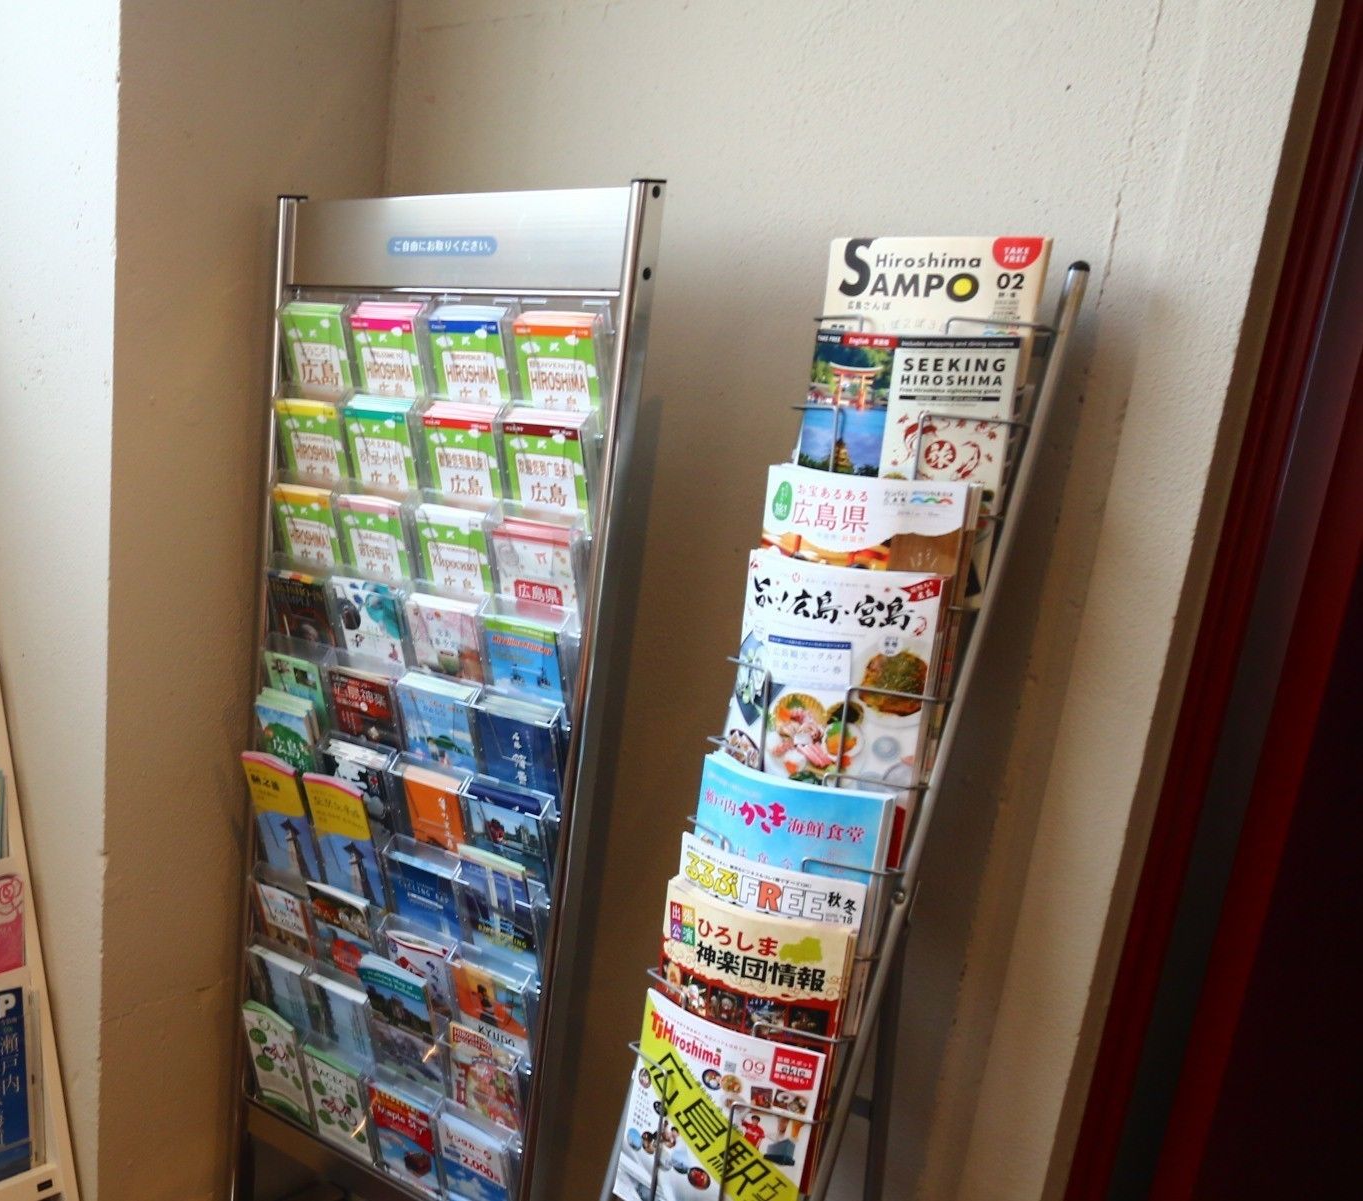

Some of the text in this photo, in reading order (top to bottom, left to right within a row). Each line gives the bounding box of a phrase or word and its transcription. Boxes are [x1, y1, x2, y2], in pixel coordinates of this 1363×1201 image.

[393, 239, 492, 253] ご自由にお取りください。
[1003, 246, 1030, 256] TAKE
[875, 252, 981, 268] Hiroshima
[1002, 254, 1028, 264] FREE
[838, 237, 980, 303] SAMPO
[996, 273, 1025, 291] 02
[301, 359, 339, 386] 広島
[447, 364, 498, 385] HIROSHIMA
[903, 358, 1006, 372] SEEKING
[530, 371, 588, 392] HIROSHIMA
[900, 374, 1003, 386] HIROSHIMA
[450, 474, 484, 497] 広島
[530, 480, 568, 508] 広島
[791, 500, 870, 534] 広島県
[517, 583, 560, 605] 広島県
[685, 849, 739, 900] るるぶ
[738, 874, 828, 922] FREE
[697, 917, 779, 957] ひろしま
[696, 941, 826, 992] 神楽団情報
[0, 1031, 20, 1096] 瀬戸内
[741, 1058, 766, 1075] 09
[780, 1066, 807, 1077] ekie
